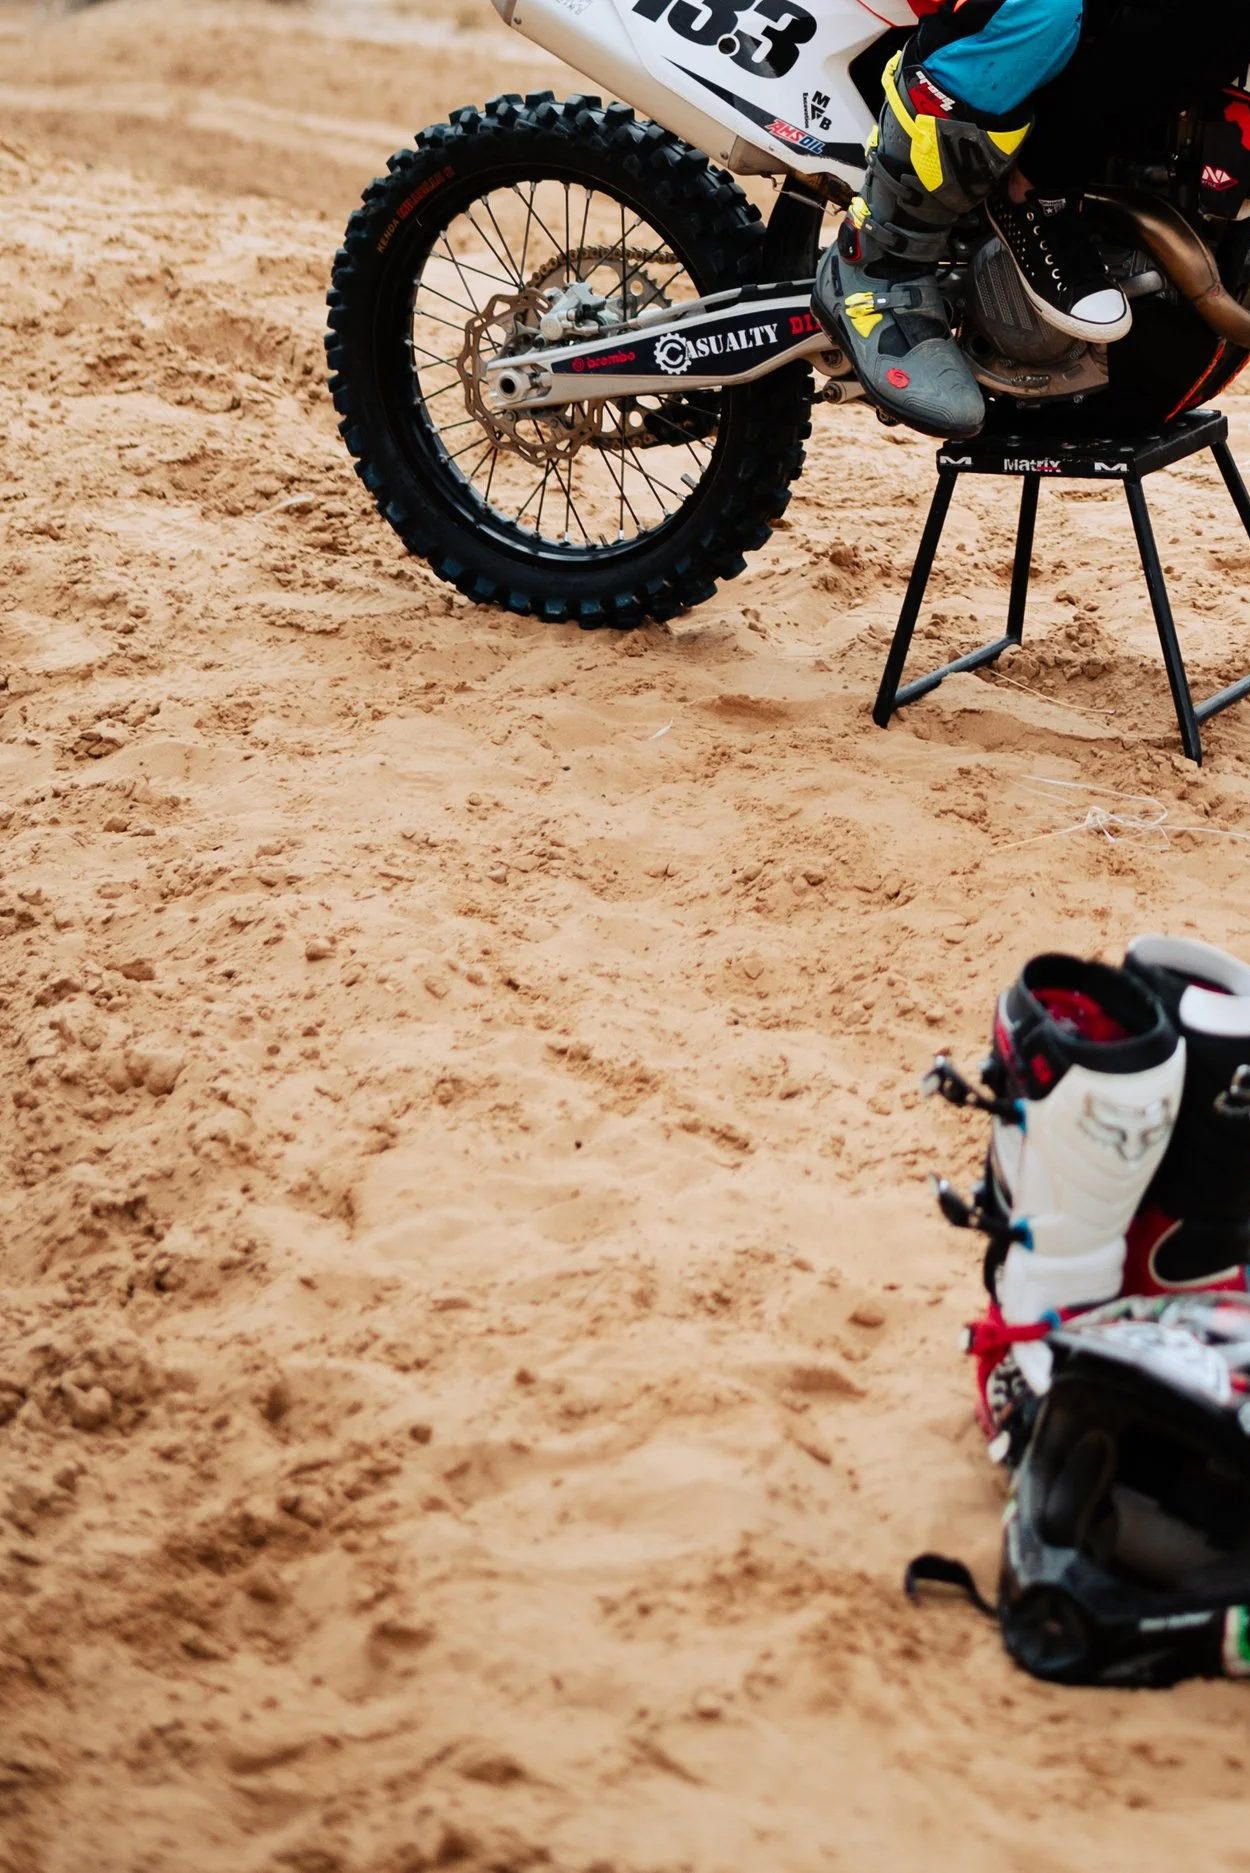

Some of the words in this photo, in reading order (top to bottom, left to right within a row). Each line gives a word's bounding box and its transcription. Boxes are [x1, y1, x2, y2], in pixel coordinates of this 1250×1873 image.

[765, 119, 826, 155] AMSOIL
[788, 312, 823, 336] DI
[586, 350, 636, 370] brembo
[653, 323, 779, 376] CASUALTY
[1003, 457, 1062, 474] Matrix
